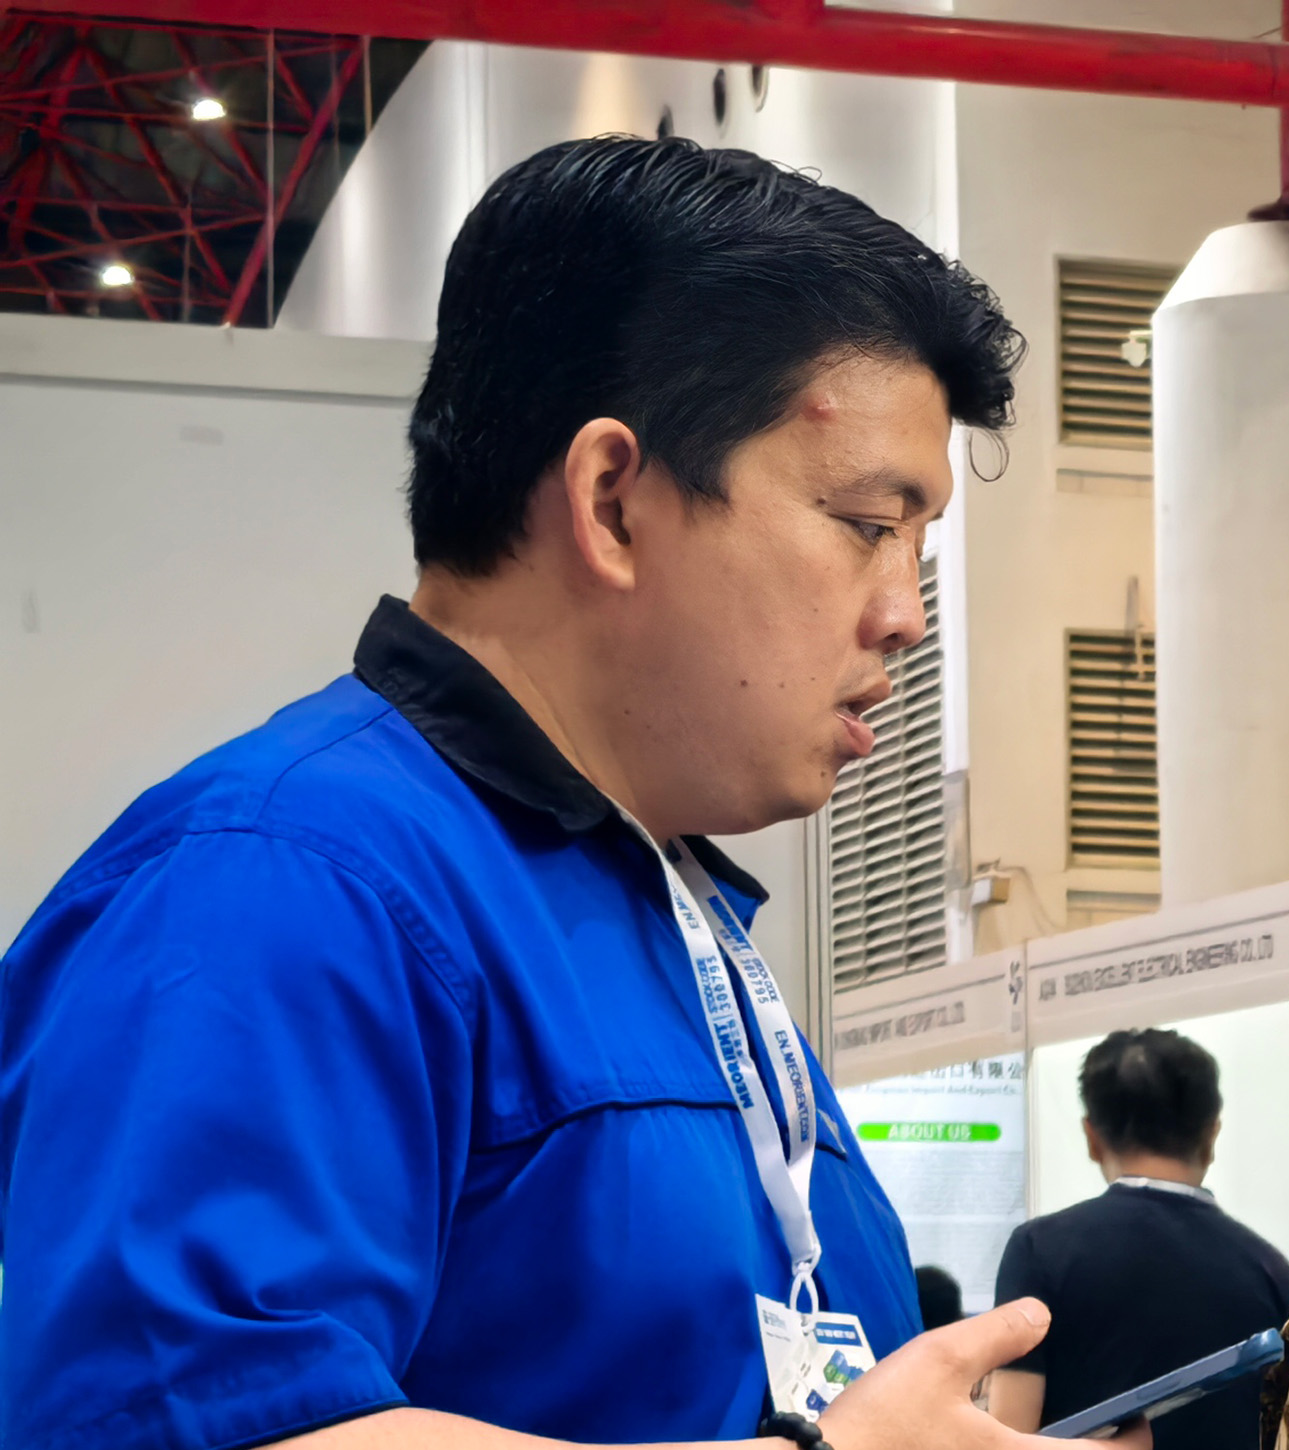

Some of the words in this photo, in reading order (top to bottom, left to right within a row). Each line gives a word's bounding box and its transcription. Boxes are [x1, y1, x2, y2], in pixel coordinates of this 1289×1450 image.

[714, 1022, 755, 1110] MEORIENT
[888, 1123, 946, 1141] ABOUT
[948, 1124, 972, 1141] US
